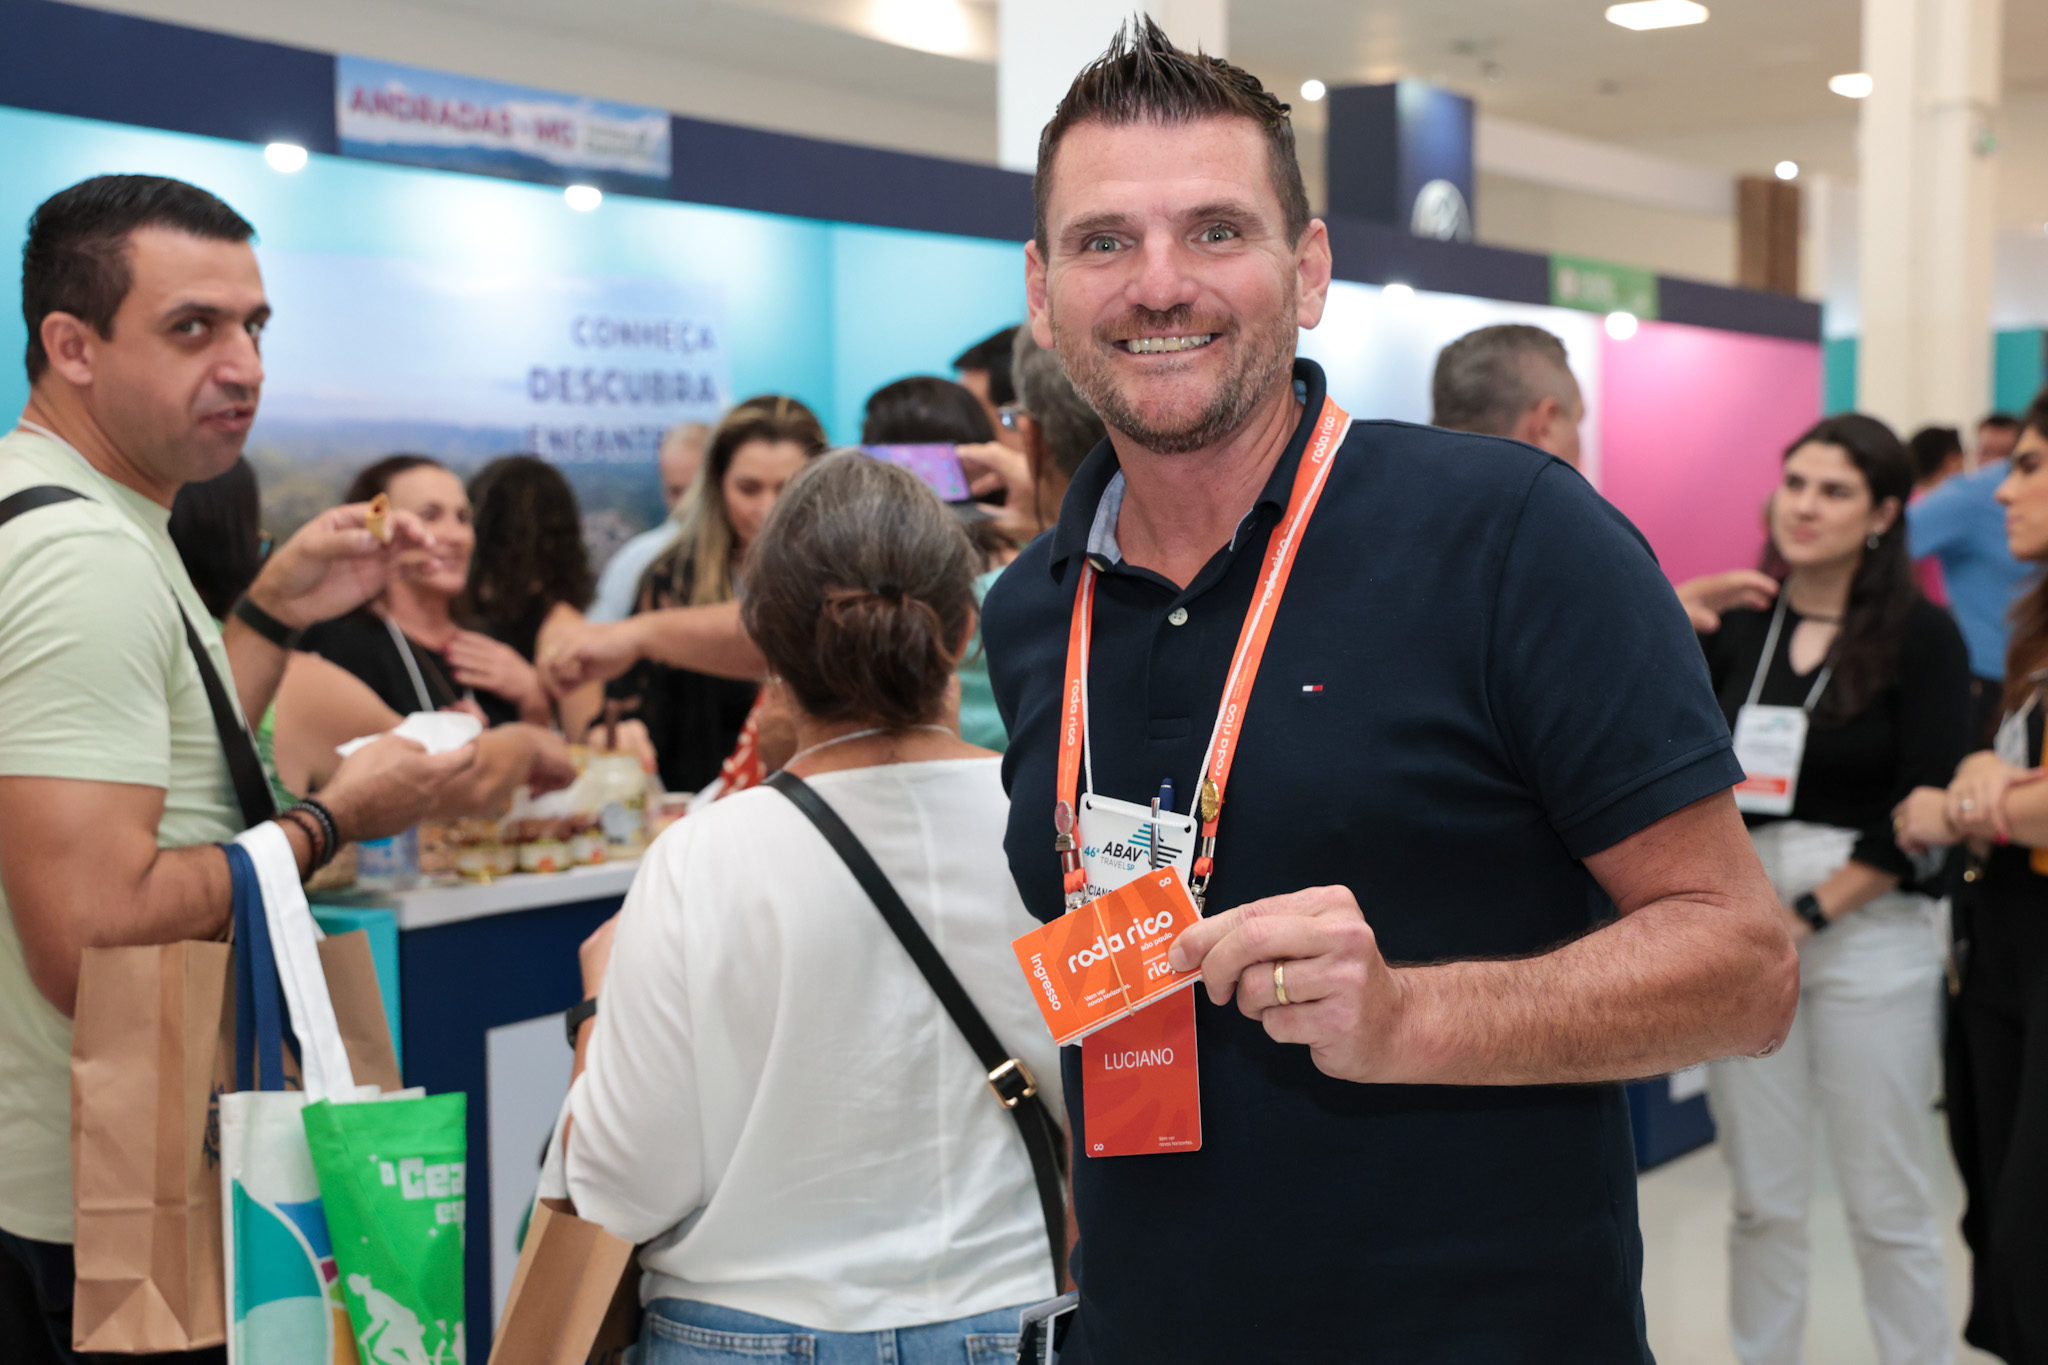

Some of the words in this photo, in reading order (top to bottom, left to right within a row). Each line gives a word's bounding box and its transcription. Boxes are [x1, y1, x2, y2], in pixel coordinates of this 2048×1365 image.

[349, 85, 513, 139] ANDRADAS
[571, 315, 717, 355] CONHEÇA
[528, 366, 717, 404] DESCUBRA
[1320, 416, 1336, 436] rico
[1070, 678, 1081, 714] roda
[1067, 716, 1079, 746] rico
[1221, 703, 1237, 735] rico
[1215, 738, 1229, 776] roda
[1102, 841, 1143, 862] ABAV
[1067, 935, 1126, 973] roda
[1126, 910, 1174, 945] rico
[1030, 952, 1062, 1011] Ingresso
[1147, 961, 1172, 980] ric
[1104, 1047, 1174, 1070] LUCIANO
